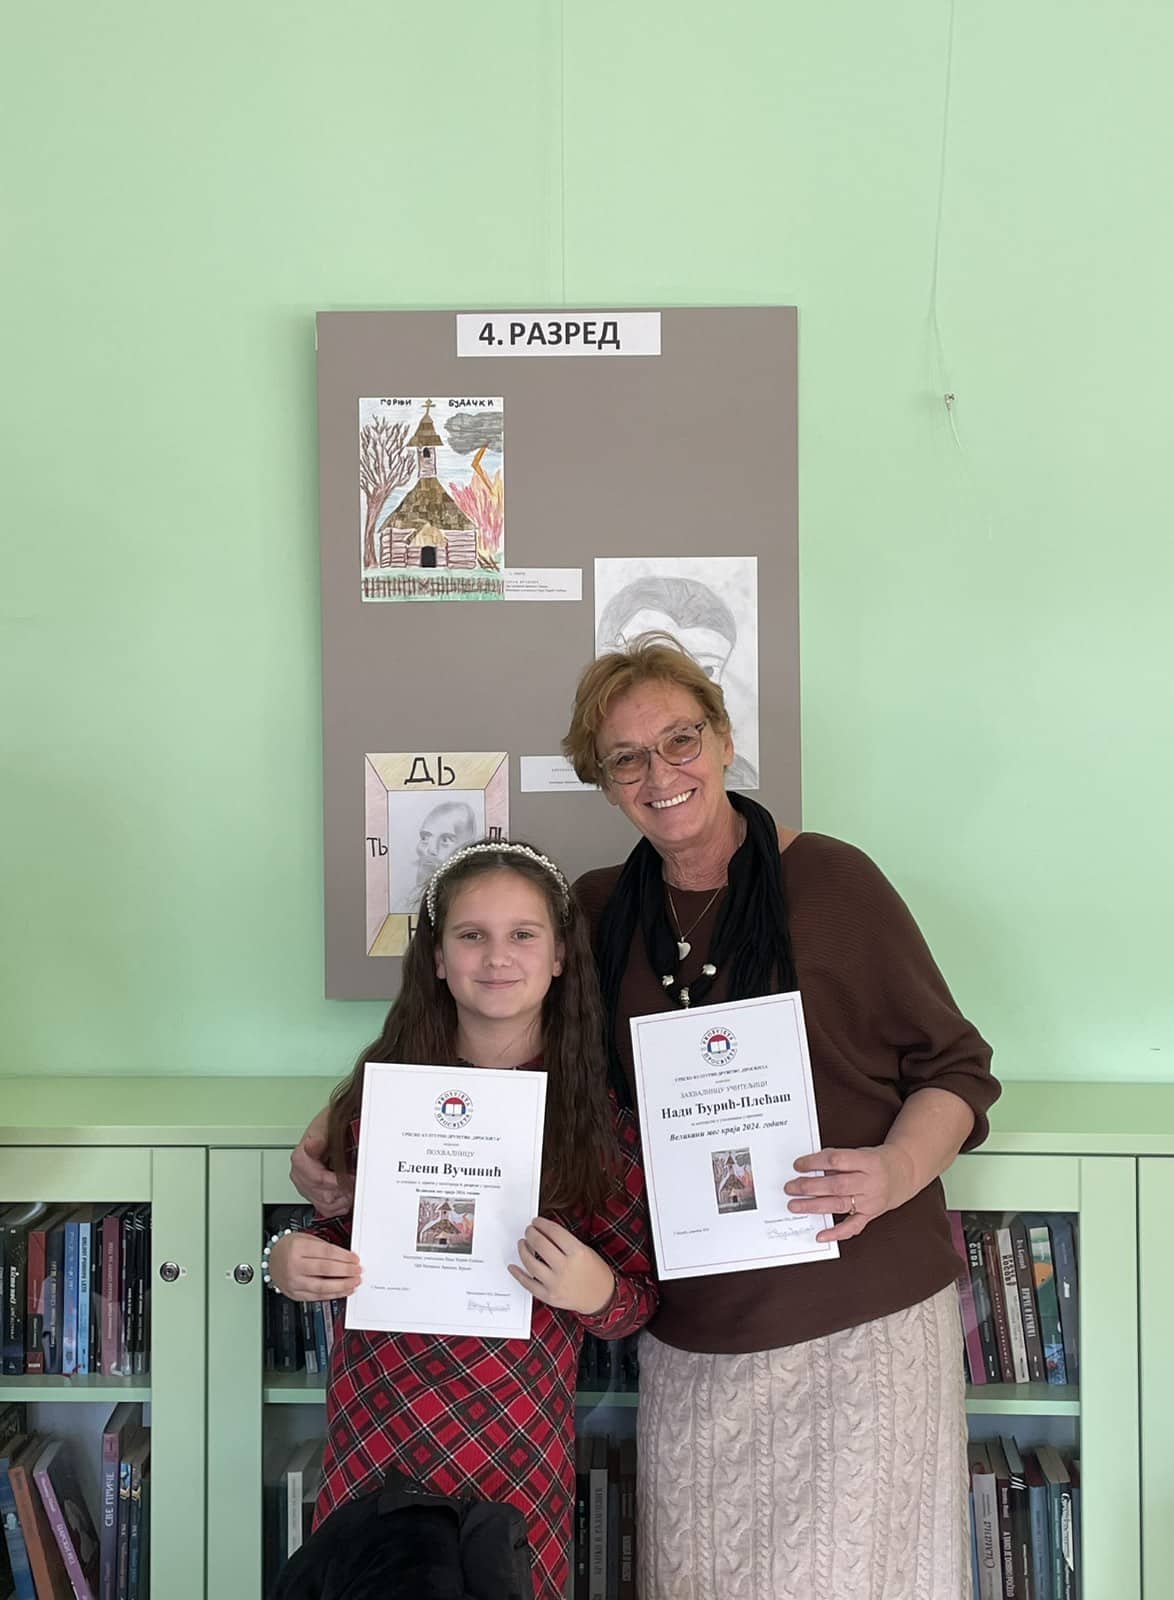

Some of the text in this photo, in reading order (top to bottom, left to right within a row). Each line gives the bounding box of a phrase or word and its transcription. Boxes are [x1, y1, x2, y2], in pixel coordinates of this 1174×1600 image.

[478, 321, 621, 350] 4. РАЗРЕД
[448, 399, 494, 408] БУДАЧКИ
[661, 1093, 791, 1119] Нади Ђурић-Плећаш
[669, 1131, 705, 1141] Великани
[721, 1126, 741, 1136] краја
[742, 1122, 761, 1131] 2024.
[397, 1160, 502, 1178] Елени Вучинић
[105, 1472, 115, 1527] СВЕ ПРИЧЕ
